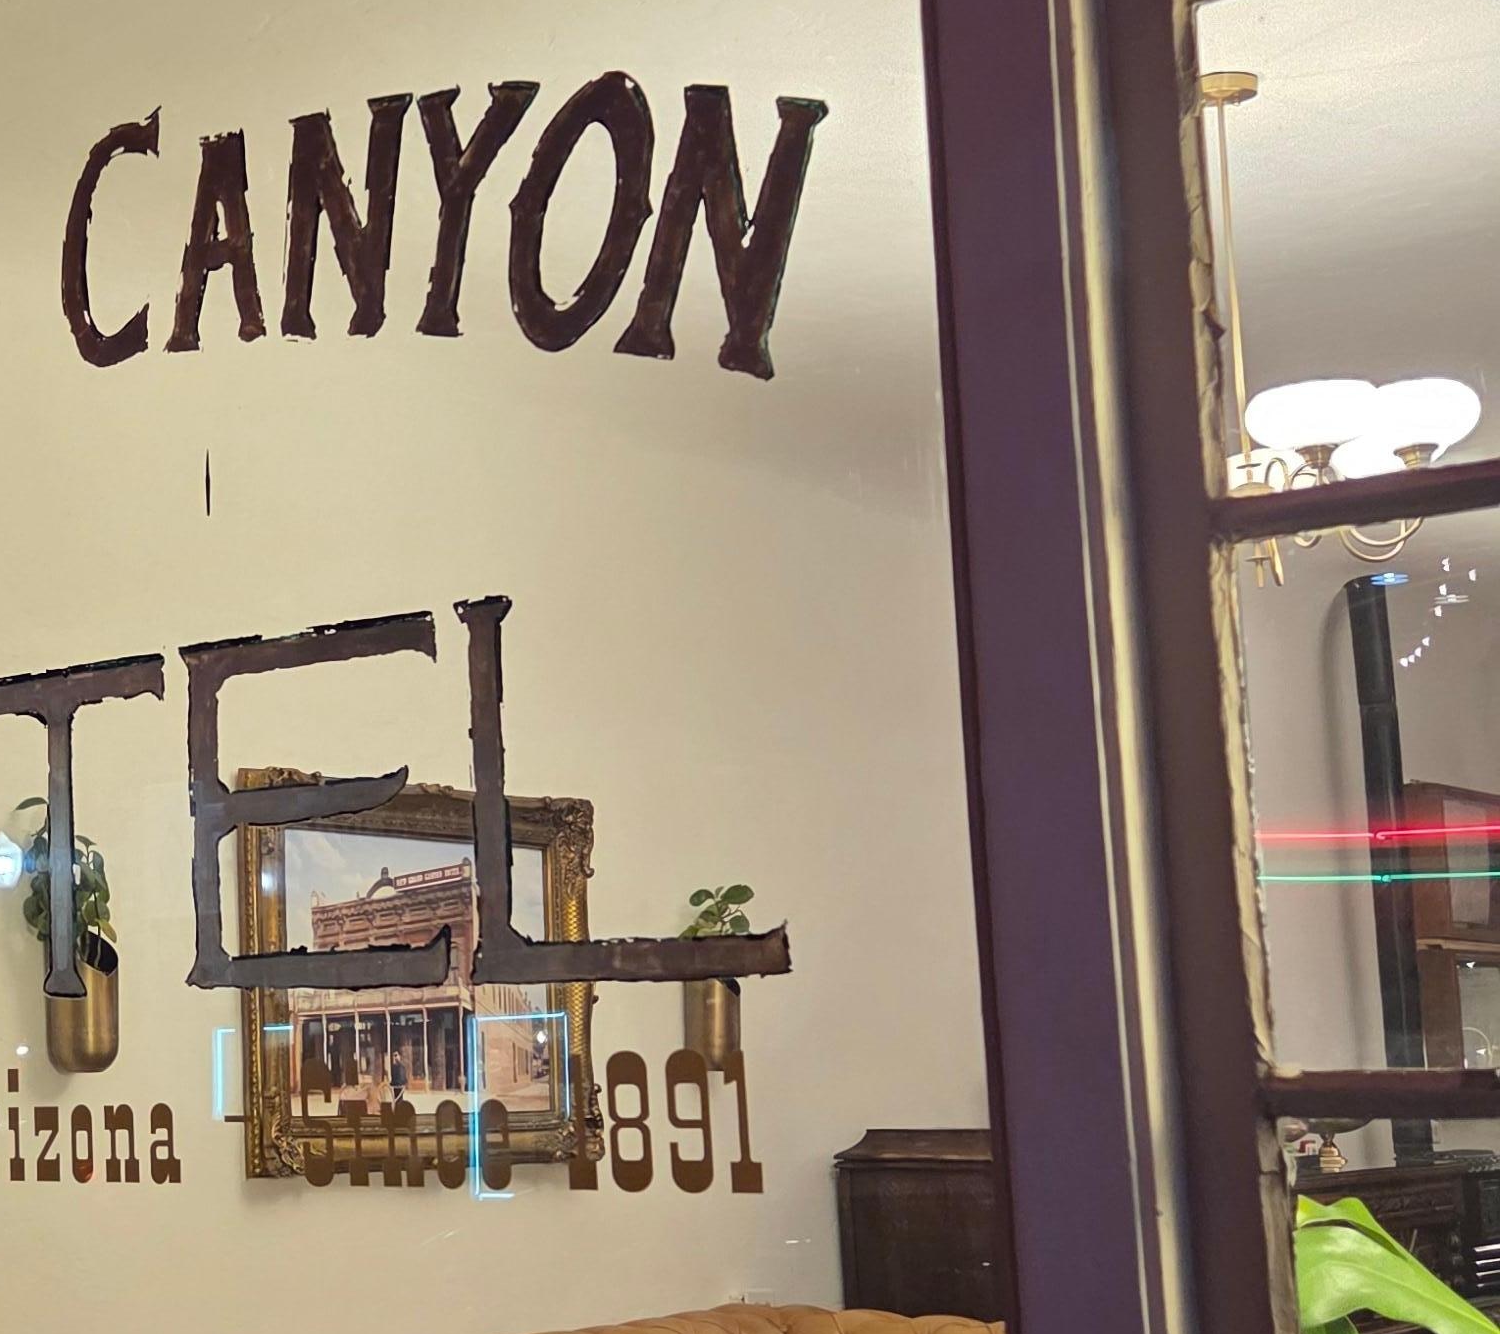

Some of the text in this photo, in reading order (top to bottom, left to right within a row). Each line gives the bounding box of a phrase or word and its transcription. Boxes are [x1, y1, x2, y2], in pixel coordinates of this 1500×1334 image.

[61, 70, 829, 379] CANYON
[301, 1056, 512, 1190] Since
[567, 1048, 764, 1193] 1891
